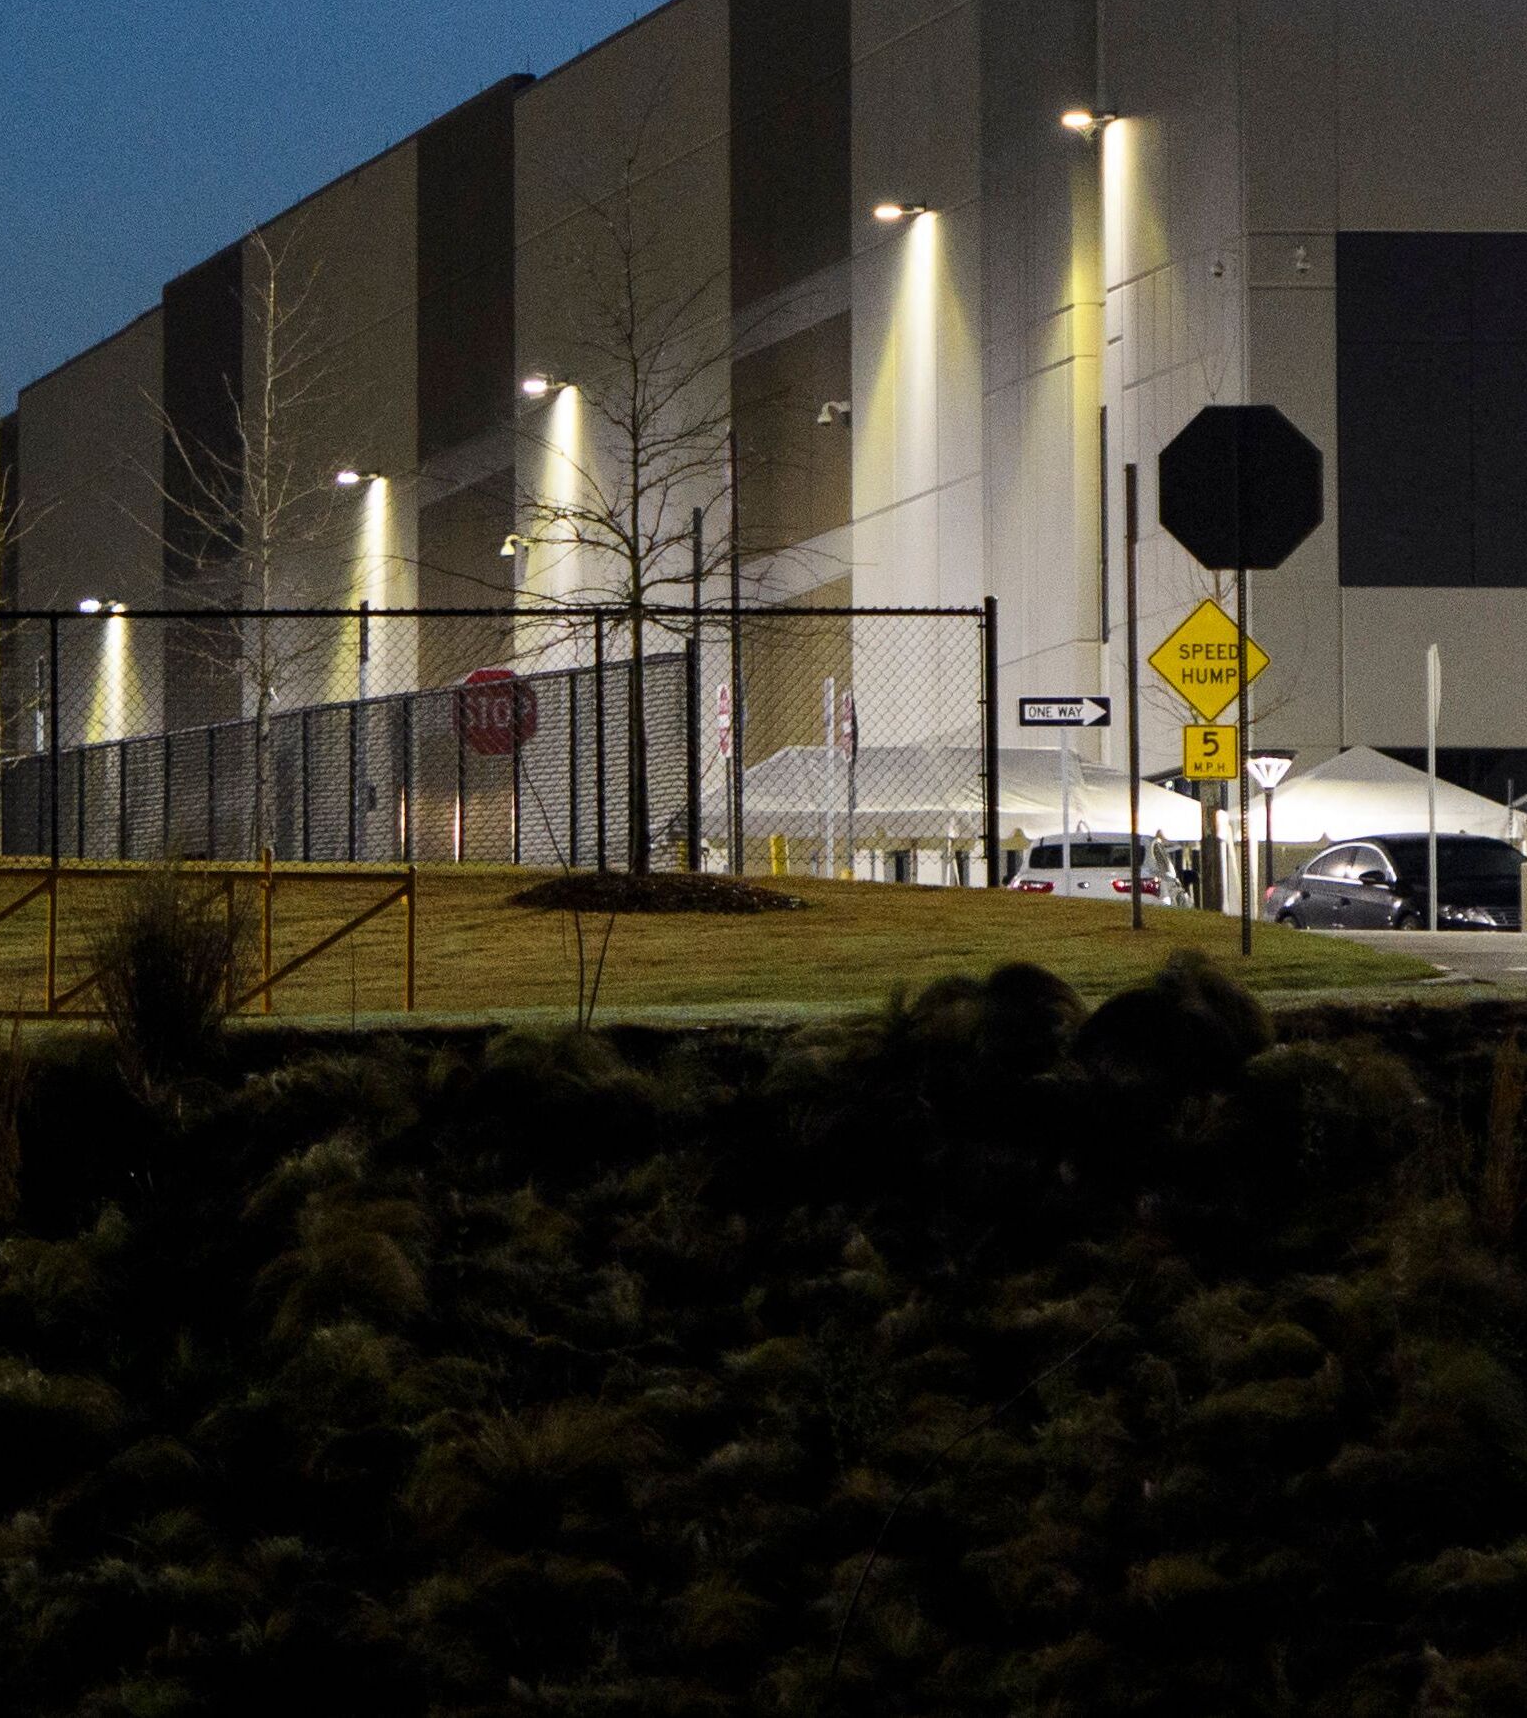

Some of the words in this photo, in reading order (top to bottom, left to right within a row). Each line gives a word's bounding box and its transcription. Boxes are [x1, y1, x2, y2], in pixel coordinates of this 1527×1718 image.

[1179, 643, 1241, 661] SPEED
[1182, 667, 1238, 684] HUMP
[1028, 706, 1053, 719] ONE
[1058, 706, 1084, 718] WAY
[1202, 731, 1220, 758] 5
